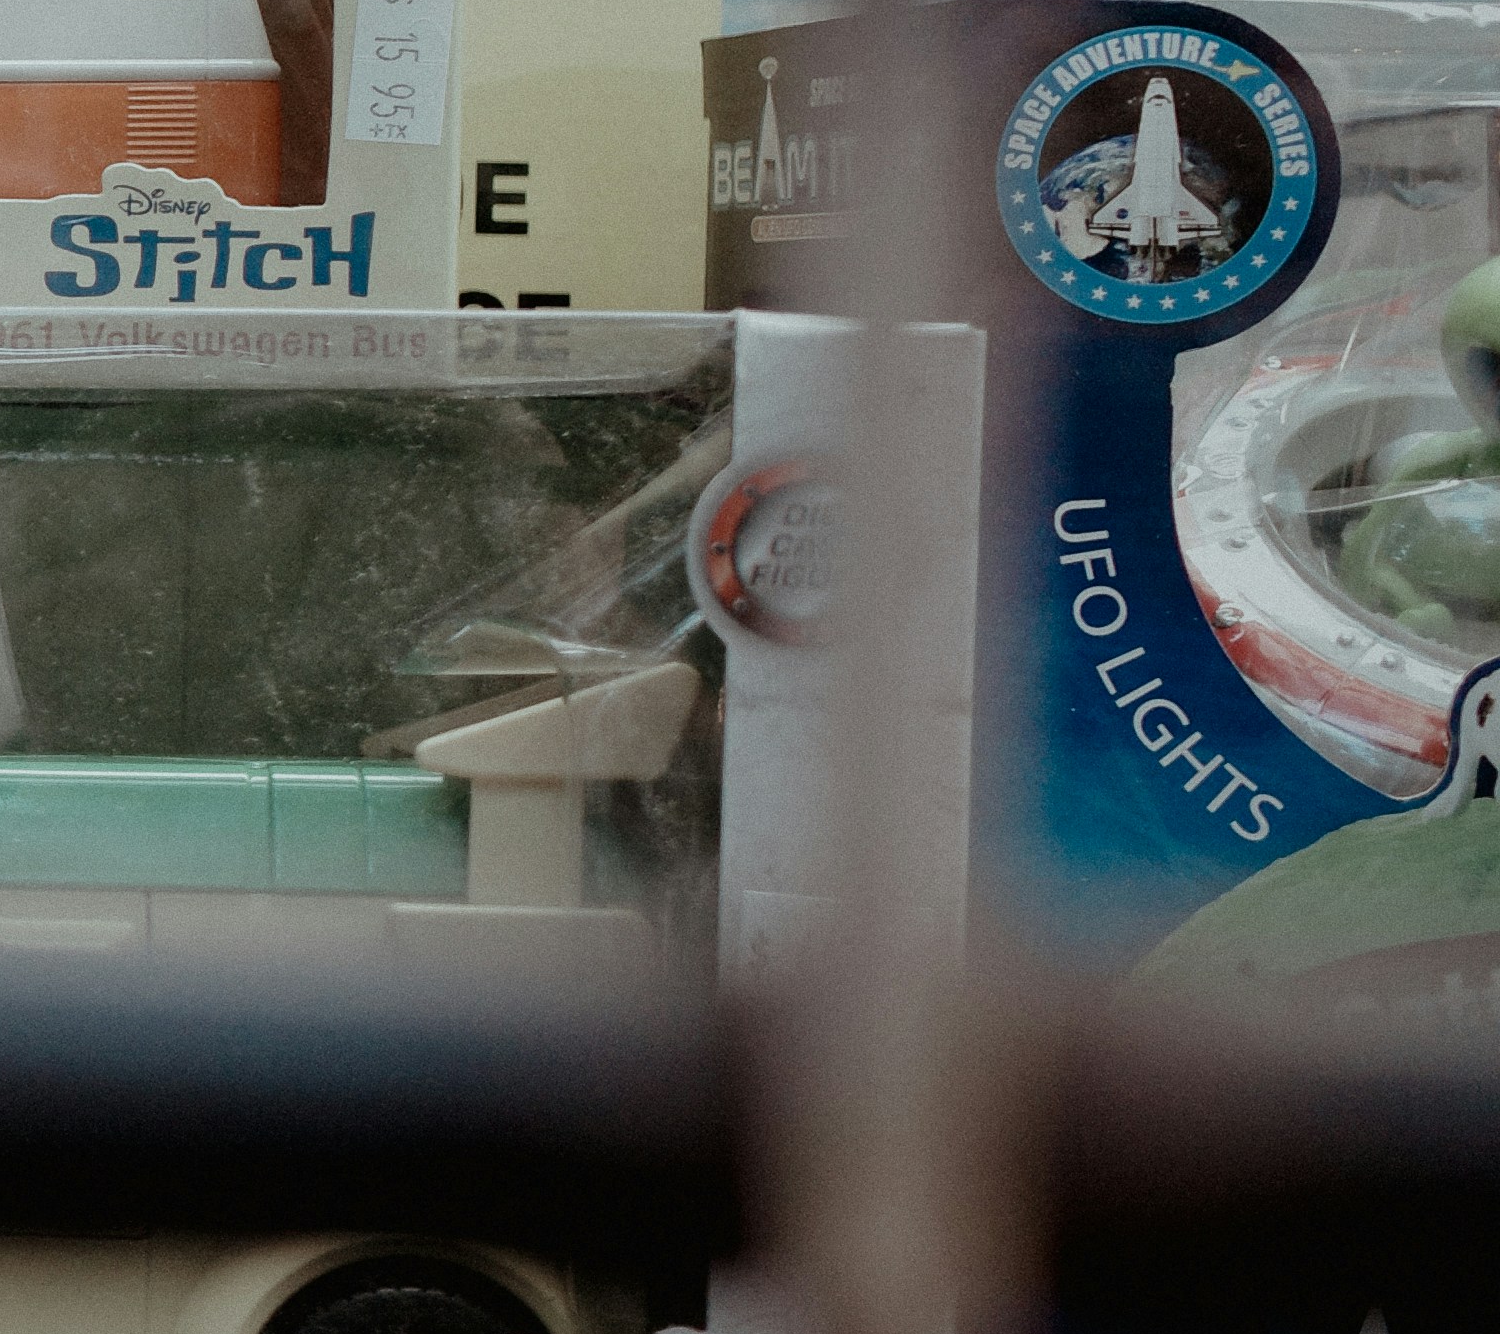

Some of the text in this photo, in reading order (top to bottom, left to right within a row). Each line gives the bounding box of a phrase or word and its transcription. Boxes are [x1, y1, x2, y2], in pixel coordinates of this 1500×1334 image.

[1004, 32, 1310, 178] SPACE ADVENTURE SERIES
[113, 184, 211, 220] Disney
[1054, 499, 1284, 841] UFO LIGHTS
